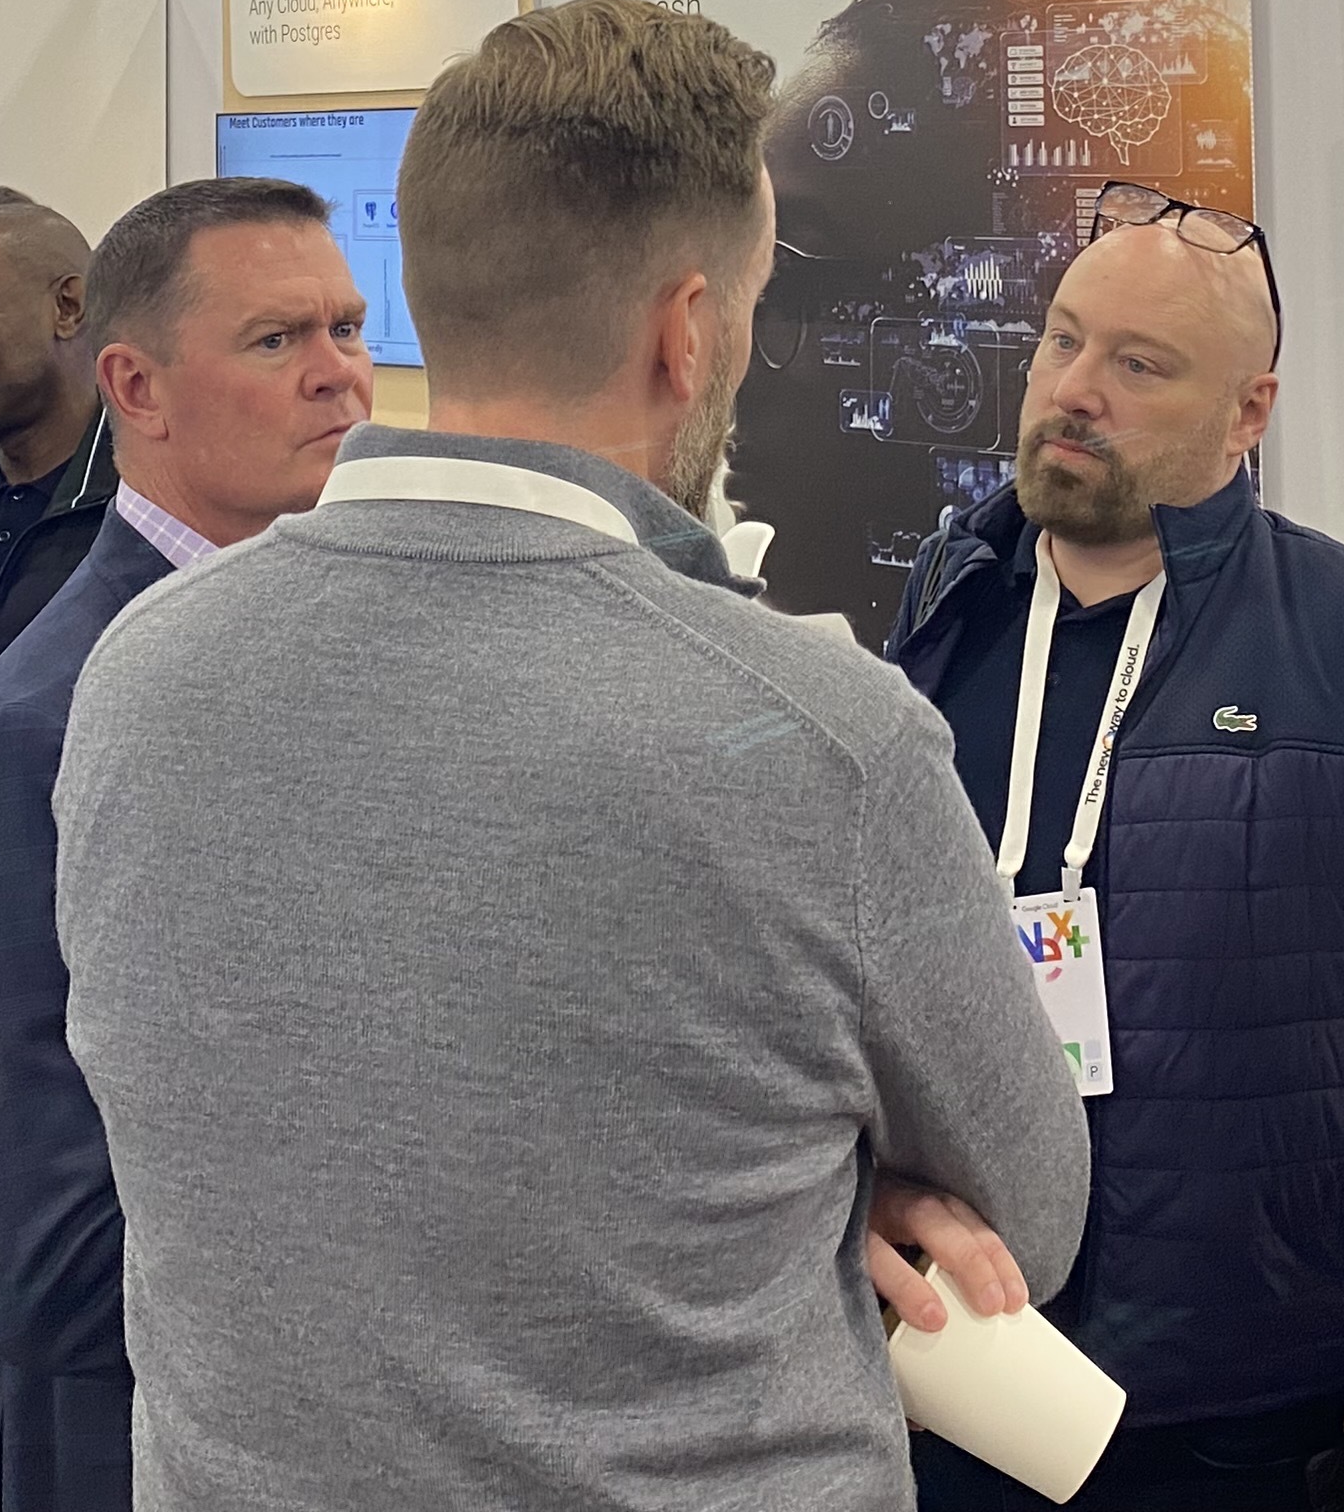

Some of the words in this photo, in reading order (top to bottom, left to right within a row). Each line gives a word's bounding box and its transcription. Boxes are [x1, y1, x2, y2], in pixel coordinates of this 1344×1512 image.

[249, 24, 278, 45] with
[281, 24, 341, 46] Postgres
[229, 117, 250, 129] Meet
[251, 115, 297, 128] Customers
[299, 114, 326, 127] where
[327, 113, 347, 128] they
[348, 114, 364, 126] are
[1120, 644, 1141, 686] cloud.
[1115, 687, 1128, 703] to
[1108, 705, 1125, 734] way
[1096, 748, 1112, 777] new
[1084, 778, 1102, 806] The
